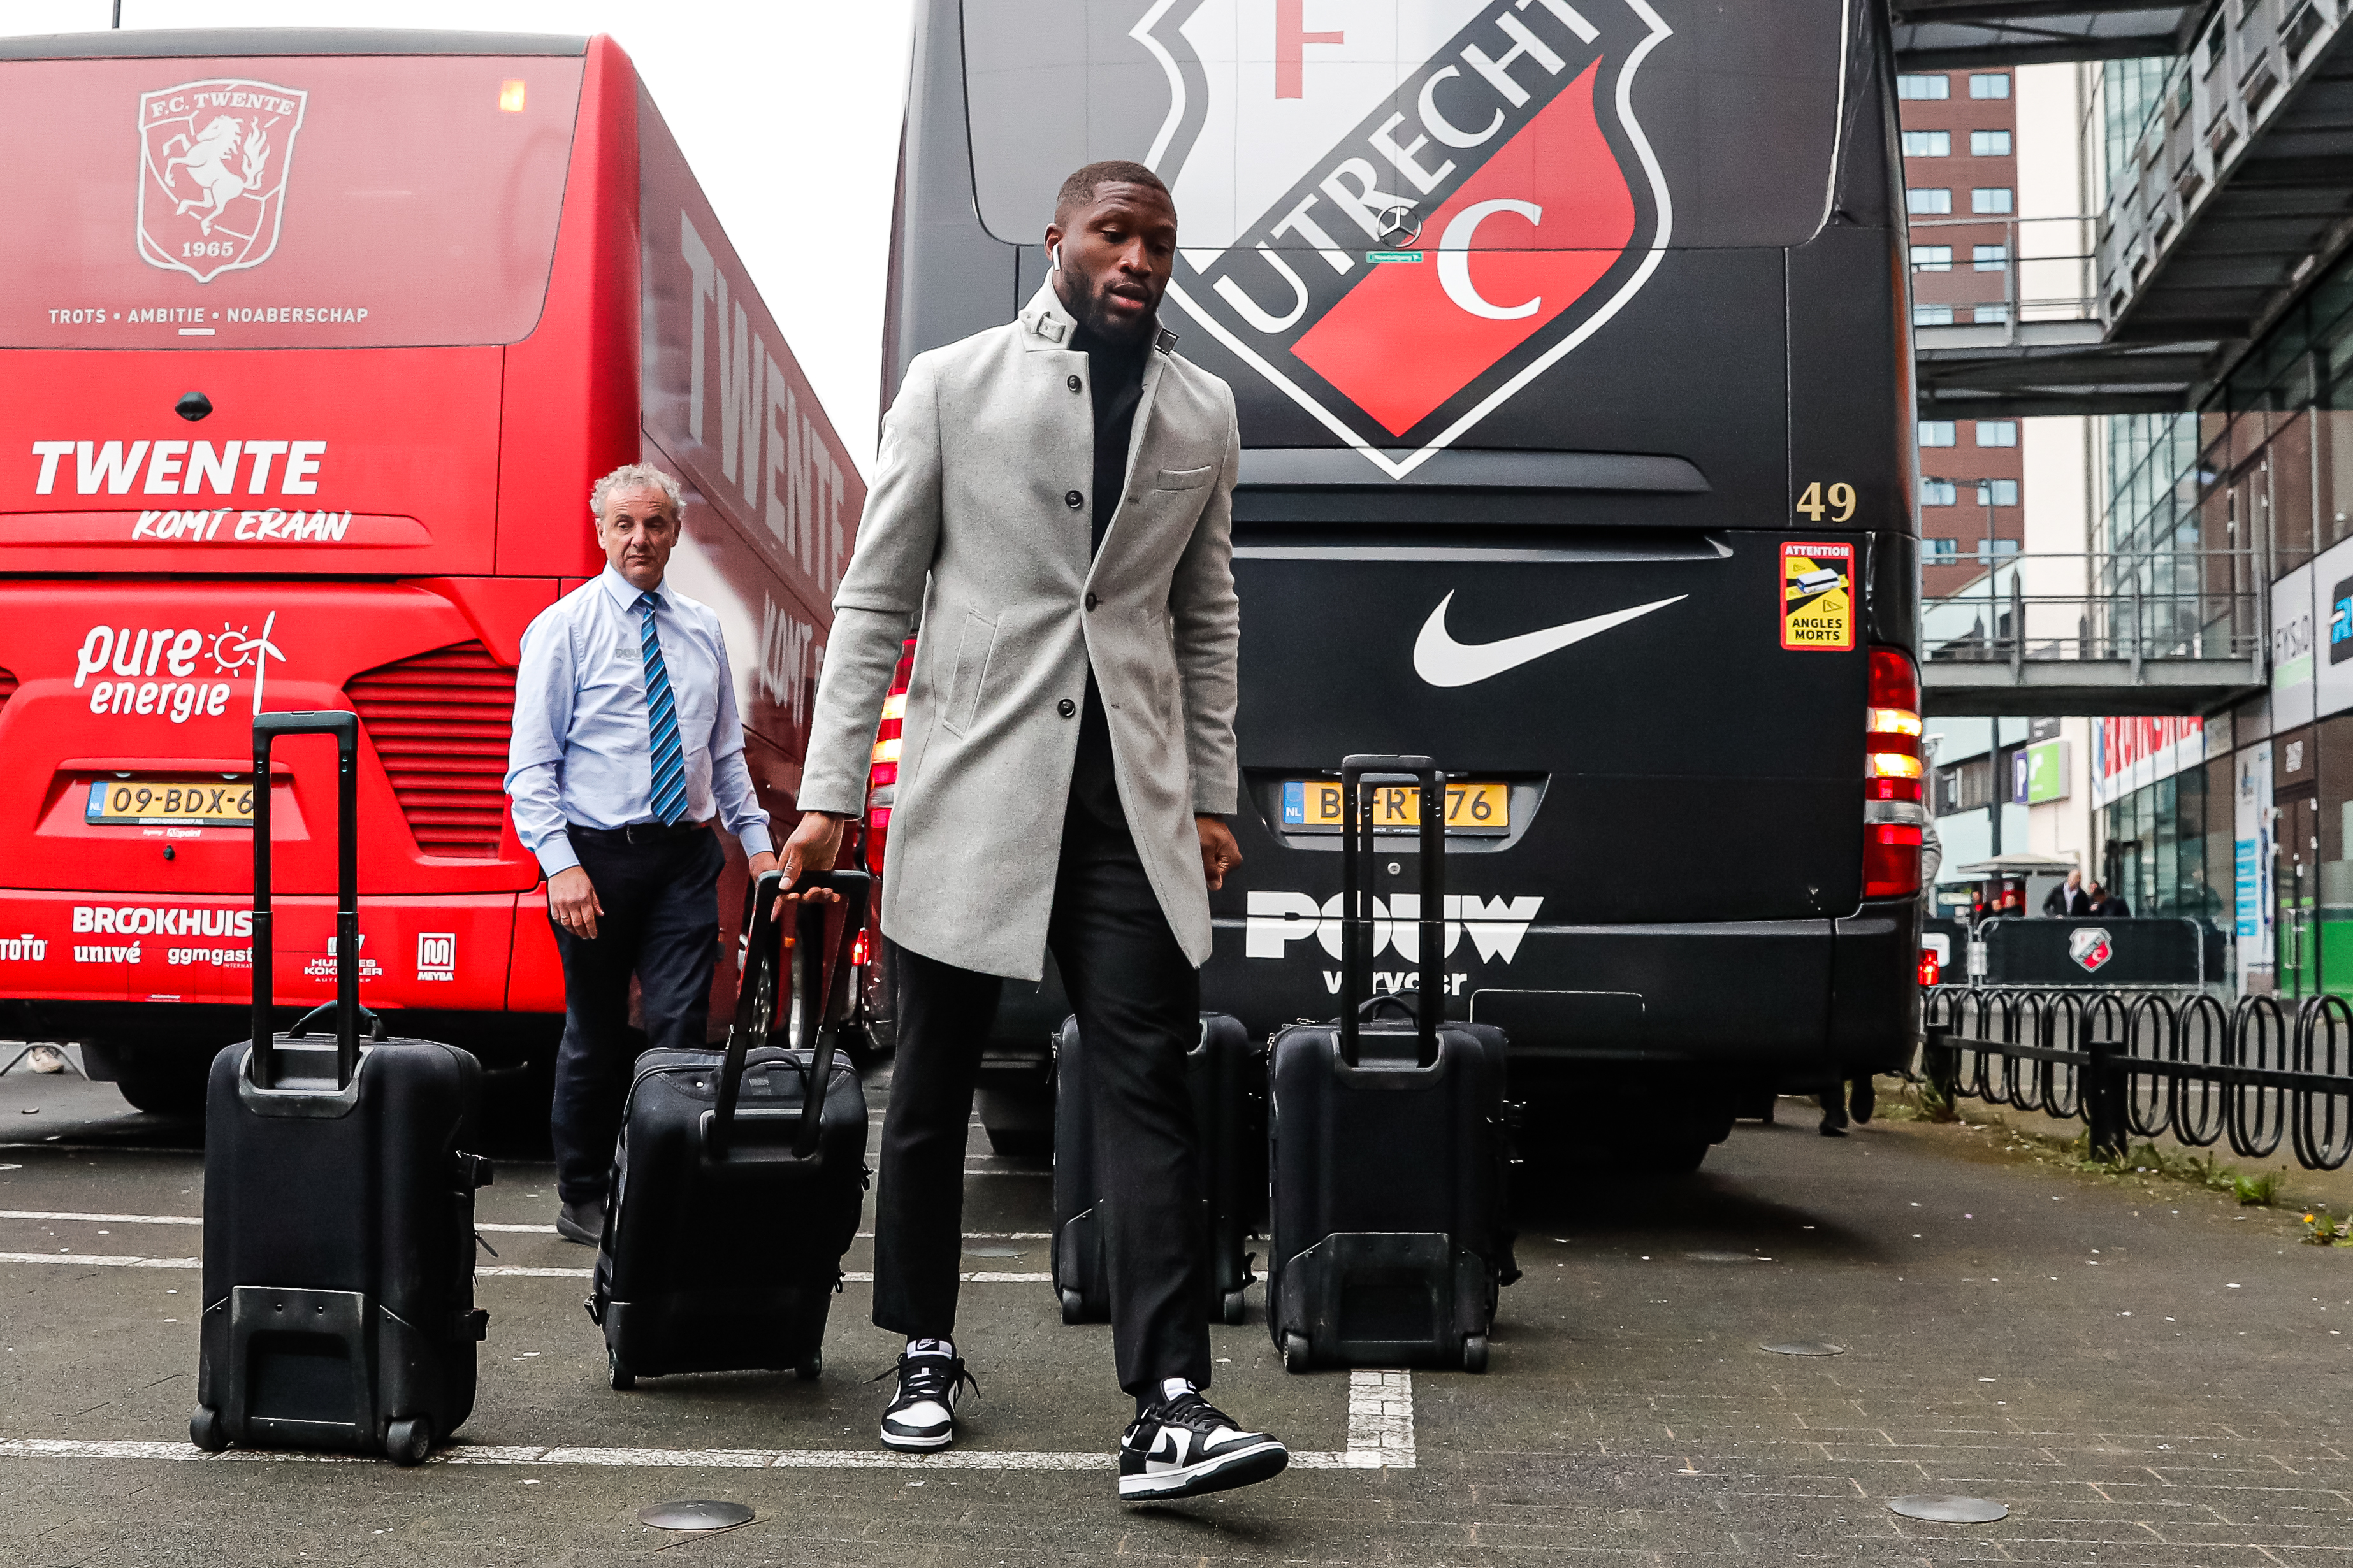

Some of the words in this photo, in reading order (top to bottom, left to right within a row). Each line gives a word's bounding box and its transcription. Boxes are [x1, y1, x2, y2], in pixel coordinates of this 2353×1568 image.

[1275, 0, 1344, 99] F
[151, 96, 189, 118] F.C.
[194, 92, 295, 116] TWENTE
[1212, 0, 1600, 334] UTRECHT
[182, 241, 234, 257] 1965
[1437, 198, 1543, 320] C
[48, 309, 106, 324] TROTS
[127, 308, 204, 323] AMBITIE
[227, 308, 368, 323] NOABERSCHAP
[681, 209, 844, 602] TWENTE
[31, 440, 327, 494] TWENTE
[1796, 482, 1857, 522] 49
[131, 507, 233, 542] KOMT
[235, 508, 352, 542] ERAAN
[1785, 545, 1849, 557] ATTENTION
[1792, 618, 1843, 629] ANGLES
[1794, 629, 1841, 641] MORTS
[73, 625, 203, 689] pure
[90, 681, 231, 724] energie
[90, 802, 101, 811] NL
[113, 788, 253, 814] 09-BDX-6
[1287, 806, 1301, 817] NL
[73, 906, 253, 937] BROOKHUIS
[73, 940, 141, 964] univé
[168, 947, 253, 966] ggmgast
